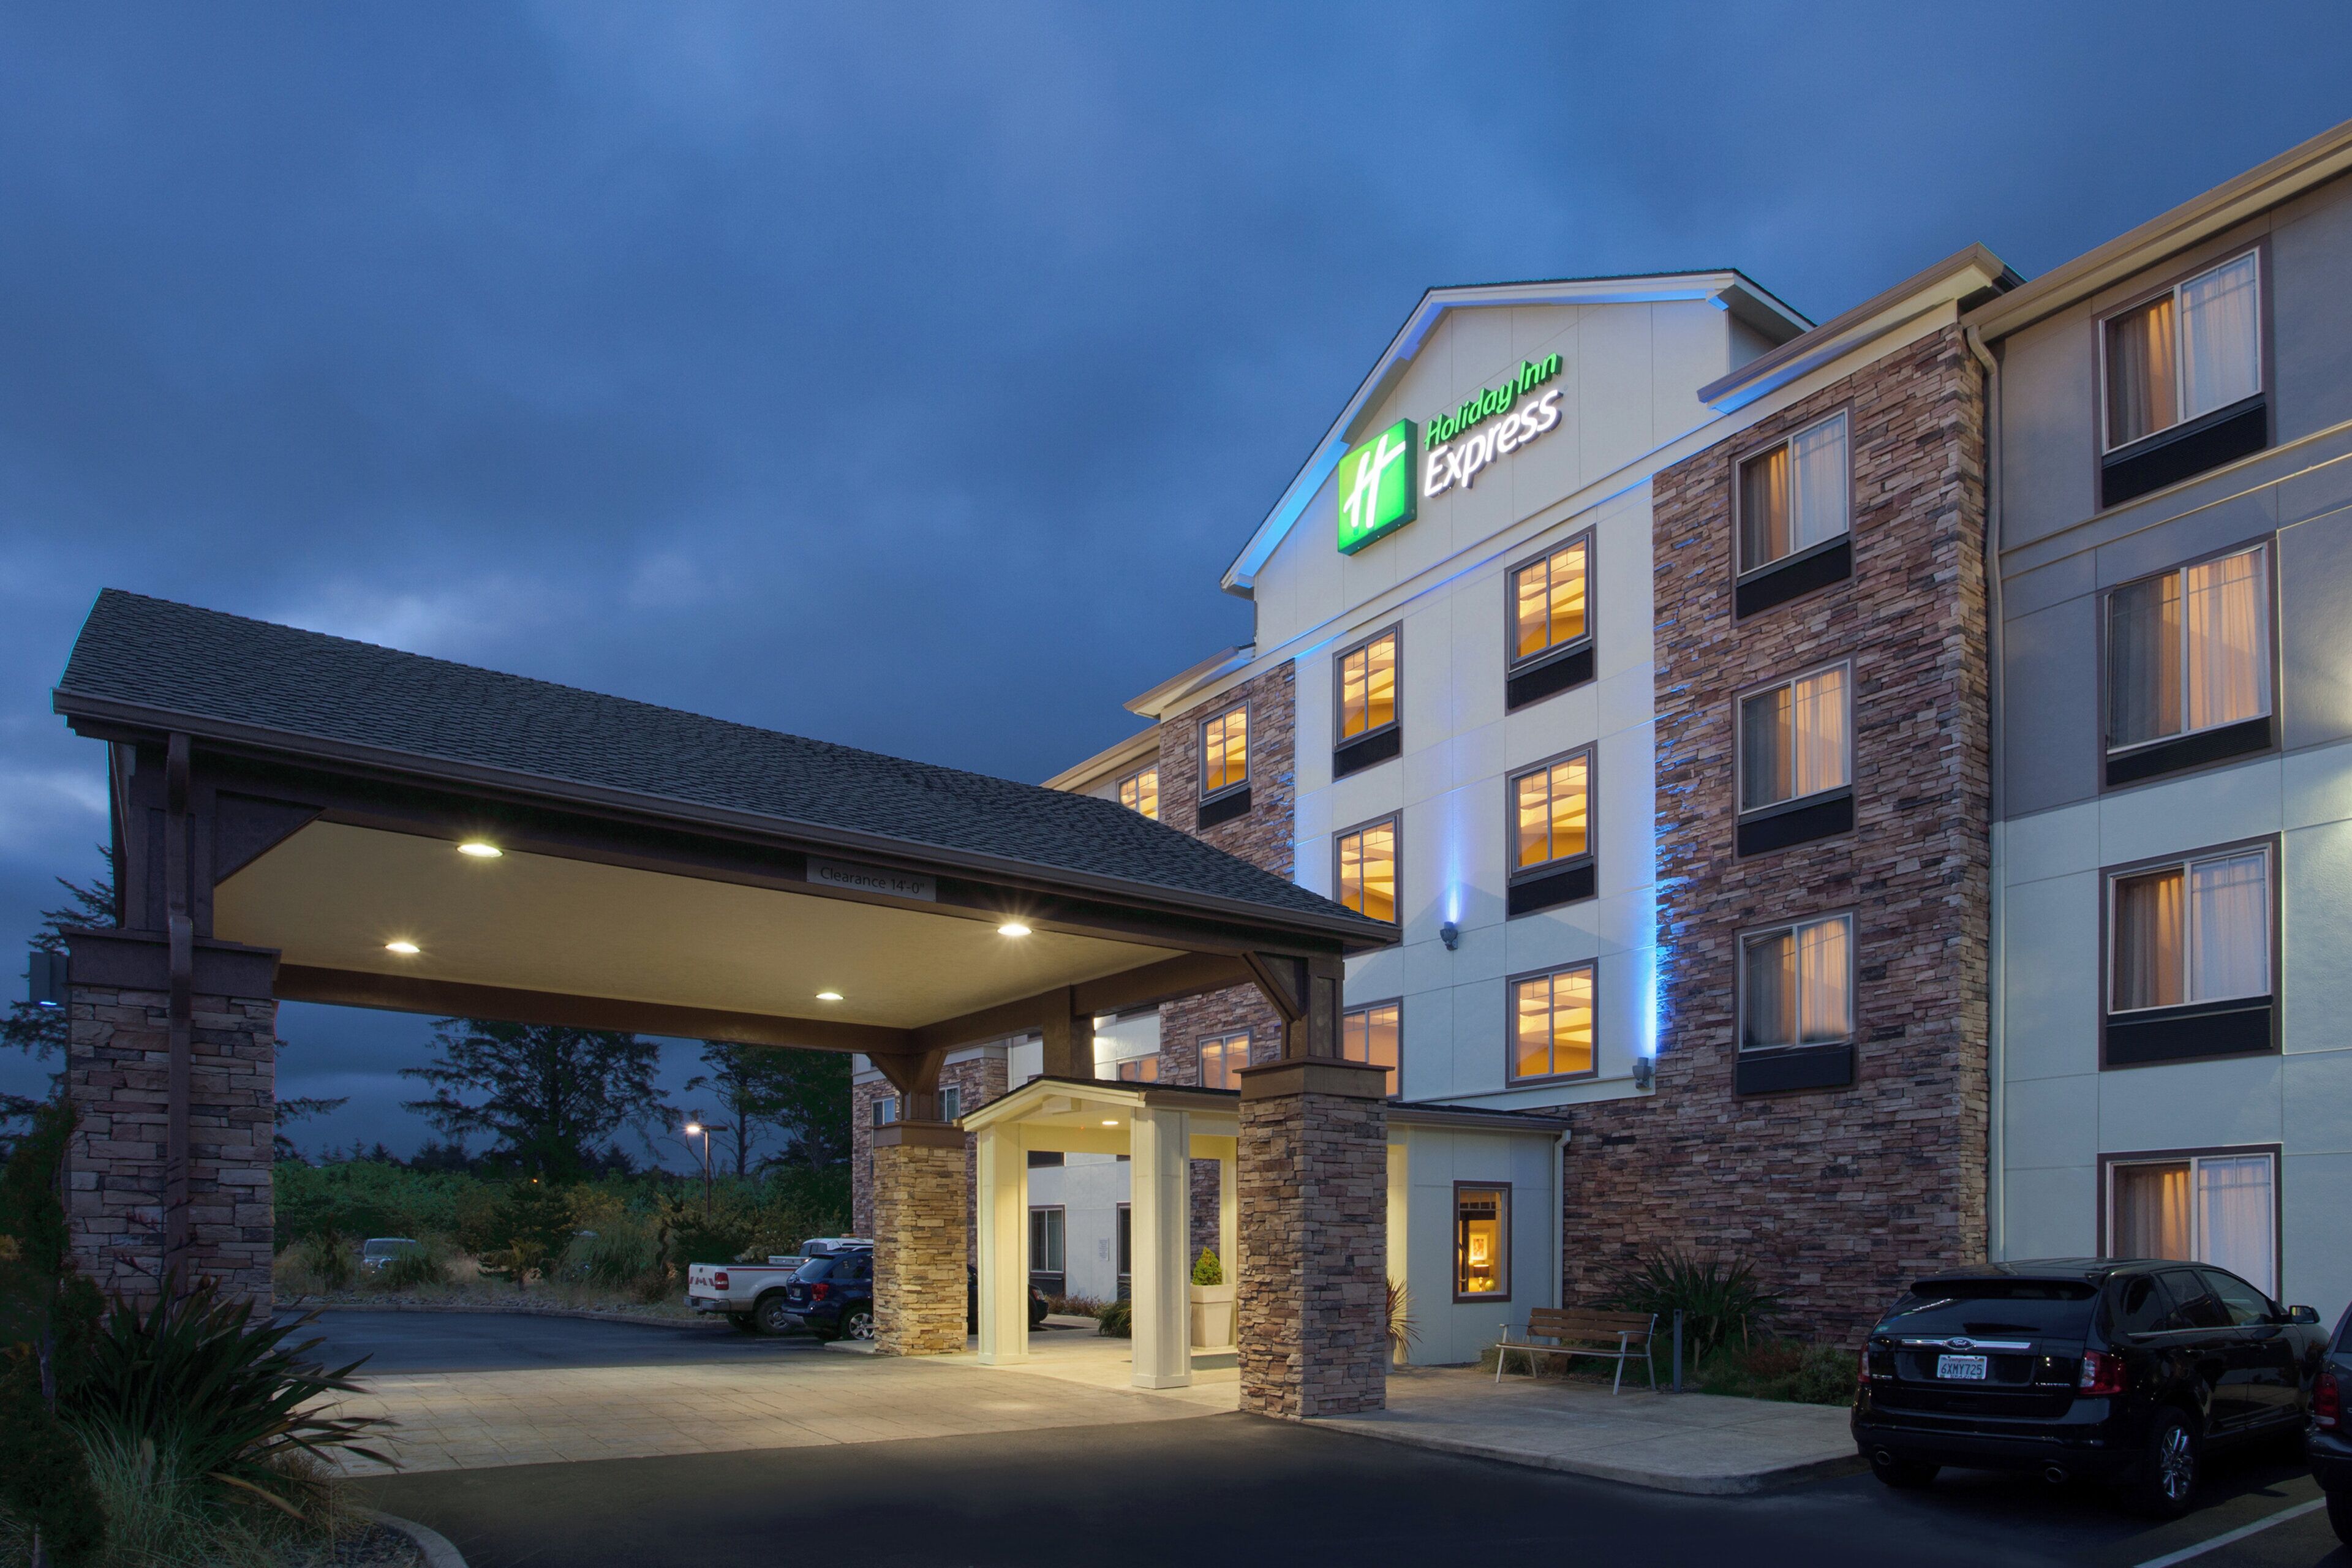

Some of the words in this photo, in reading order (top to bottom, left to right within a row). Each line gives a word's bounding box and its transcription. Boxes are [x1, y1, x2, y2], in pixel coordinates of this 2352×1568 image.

[1423, 379, 1515, 451] Holiday
[1517, 352, 1559, 394] Inn
[1423, 389, 1560, 497] Express
[820, 867, 886, 888] Clearance
[1941, 1363, 1982, 1376] 6XMY725
